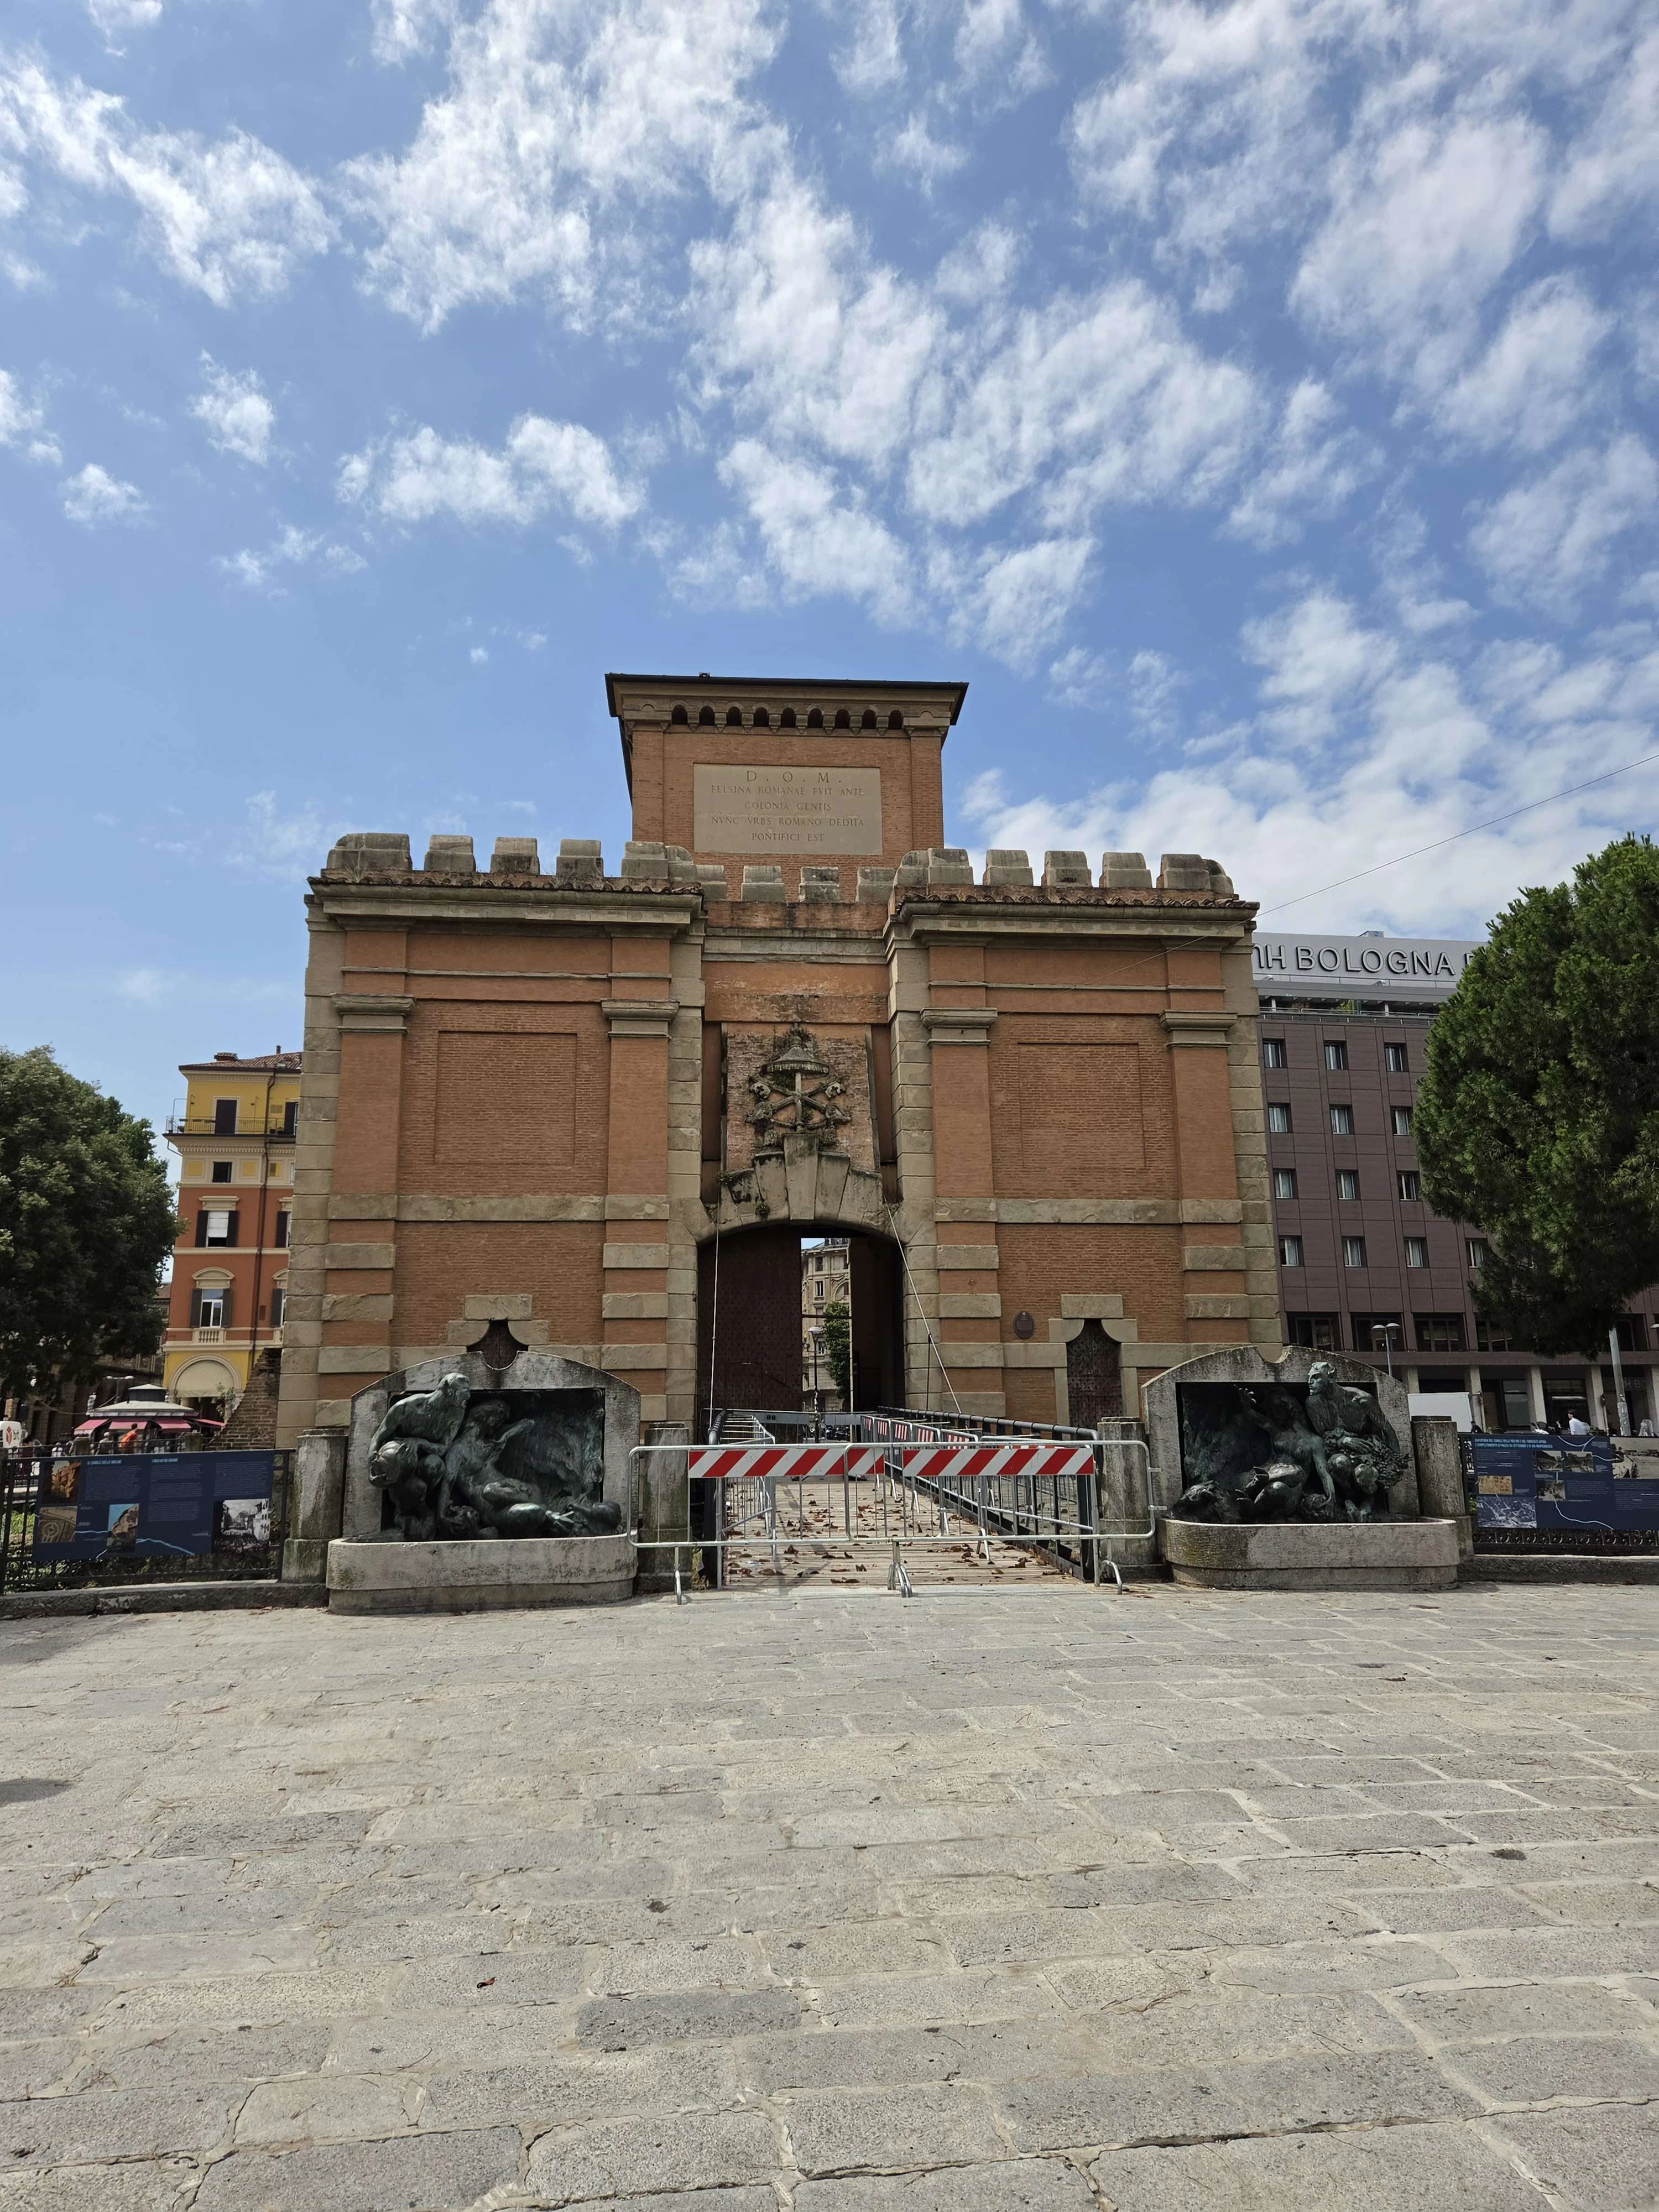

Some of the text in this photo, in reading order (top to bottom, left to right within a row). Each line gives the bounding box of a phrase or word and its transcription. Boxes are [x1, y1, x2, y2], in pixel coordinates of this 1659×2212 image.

[711, 785, 751, 794] FELSINA
[759, 786, 805, 795] ROMANAE
[744, 802, 832, 811] COLONIA GENTIS
[712, 816, 739, 825] NVNC
[829, 818, 864, 827] DEDITA
[752, 833, 800, 841] PONTIFICI
[1296, 945, 1455, 975] BOLOGNA
